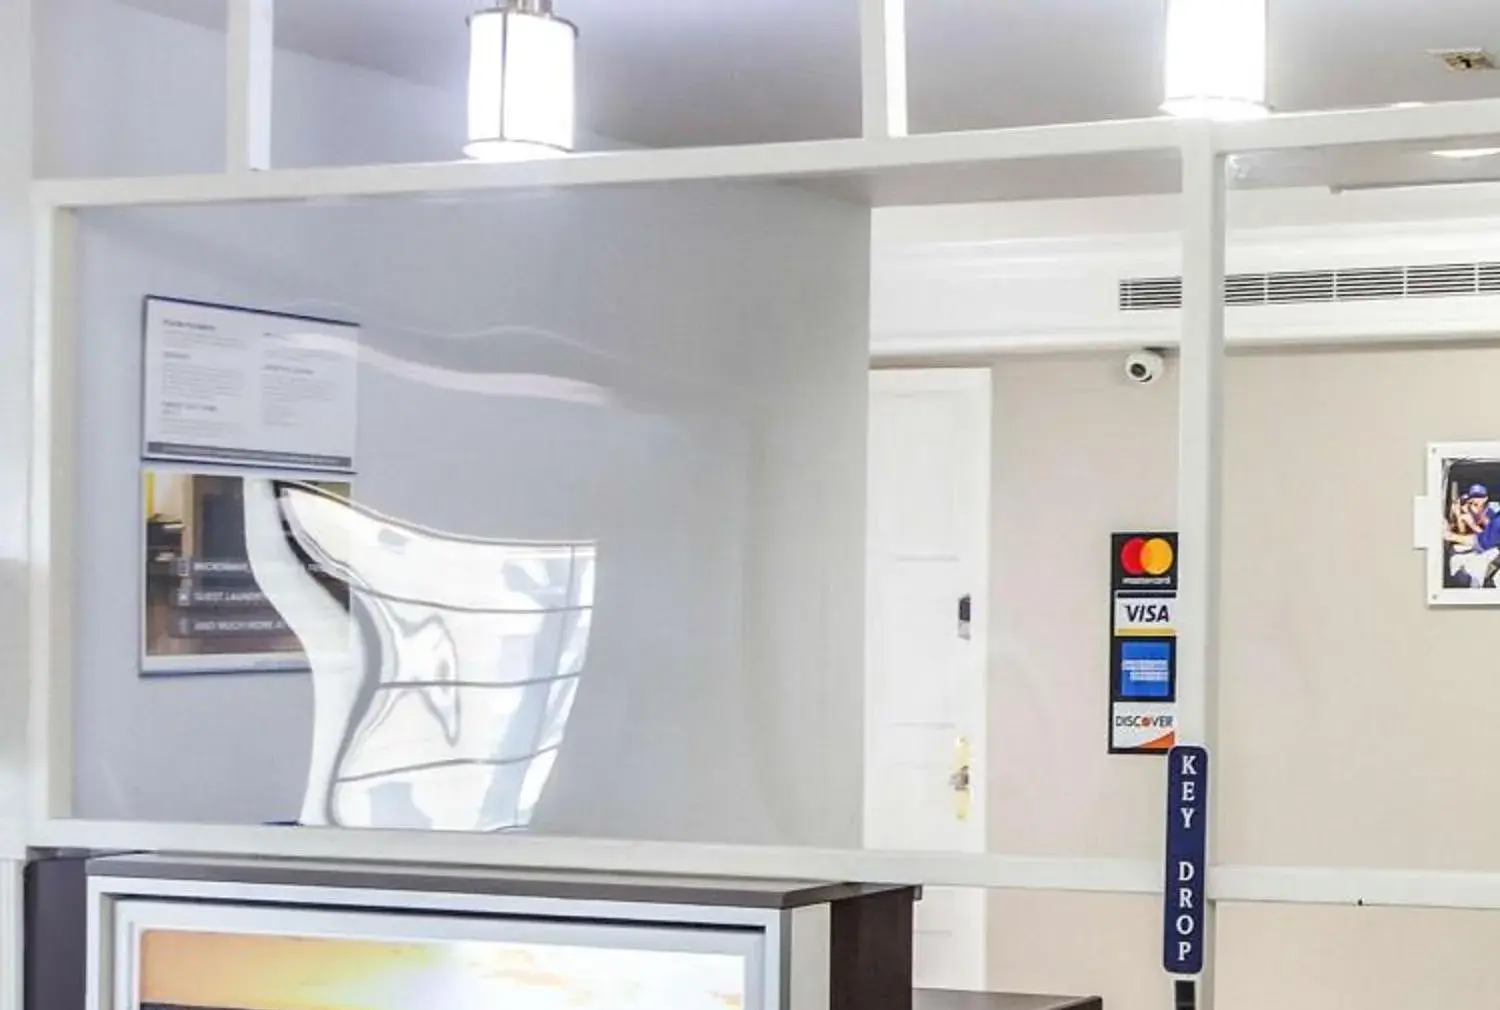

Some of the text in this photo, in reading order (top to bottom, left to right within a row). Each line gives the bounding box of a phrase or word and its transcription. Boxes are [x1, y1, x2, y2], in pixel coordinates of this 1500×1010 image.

[1124, 604, 1170, 622] VISA
[1115, 715, 1173, 727] DISCOVER
[1176, 754, 1197, 962] KEY DROP
